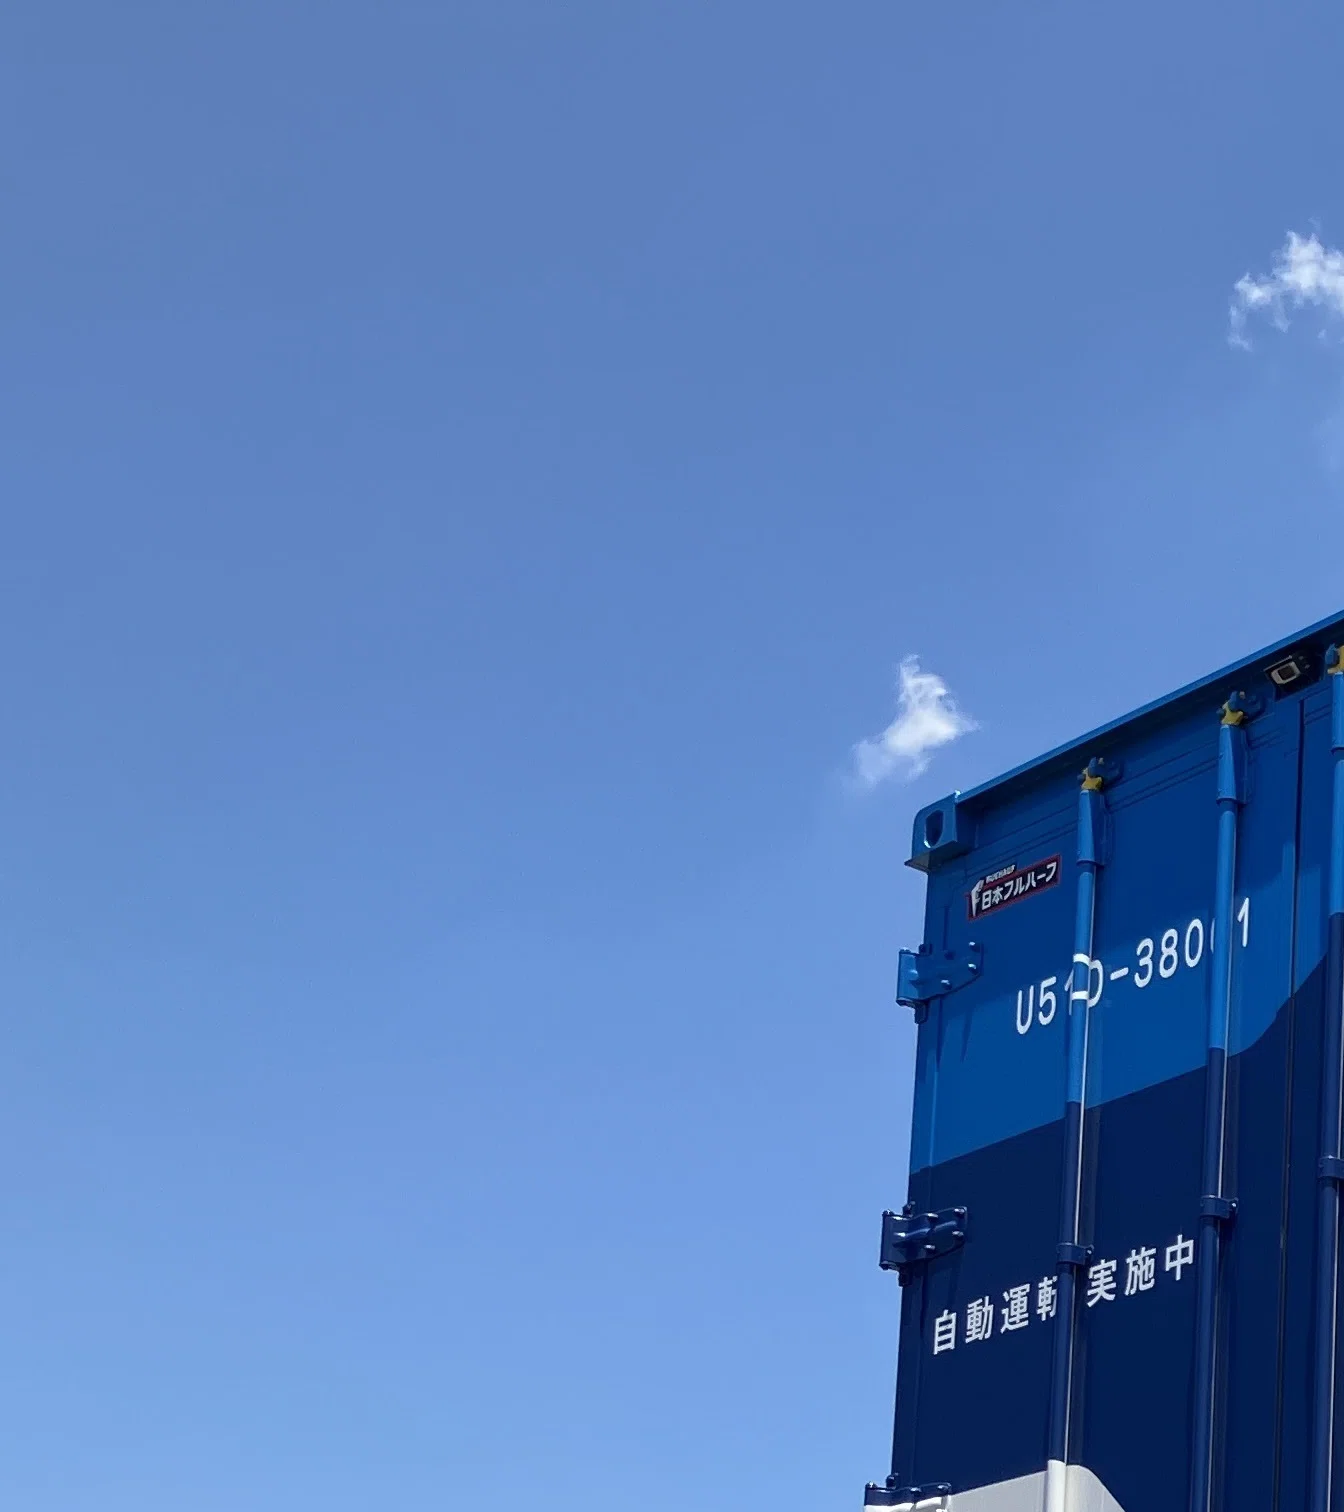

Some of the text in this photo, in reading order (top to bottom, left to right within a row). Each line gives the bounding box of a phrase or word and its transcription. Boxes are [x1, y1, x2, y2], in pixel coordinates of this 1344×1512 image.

[981, 861, 1057, 911] 日本フルハーフ
[1016, 897, 1250, 1035] U51D-3801
